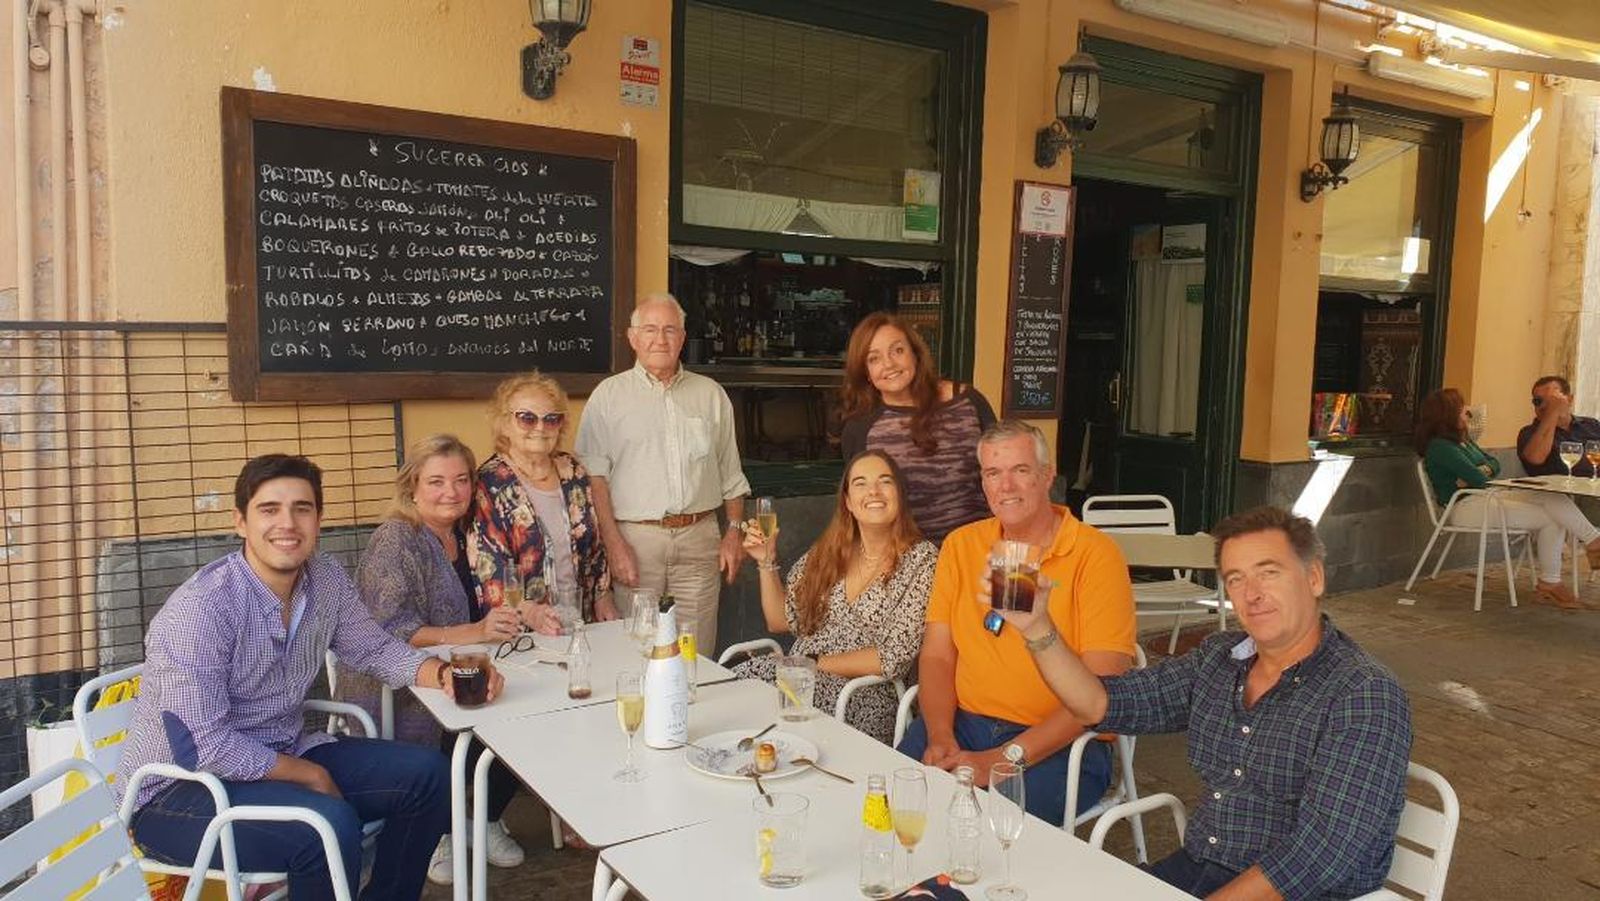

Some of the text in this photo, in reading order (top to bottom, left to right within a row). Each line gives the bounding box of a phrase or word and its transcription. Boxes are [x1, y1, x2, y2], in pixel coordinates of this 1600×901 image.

[623, 64, 658, 79] Alarma
[260, 210, 370, 232] CALAMARES
[261, 236, 379, 260] BOQUERONES
[265, 291, 345, 307] ROBALOS
[447, 290, 502, 303] GAMBAS
[436, 313, 479, 327] QUESO
